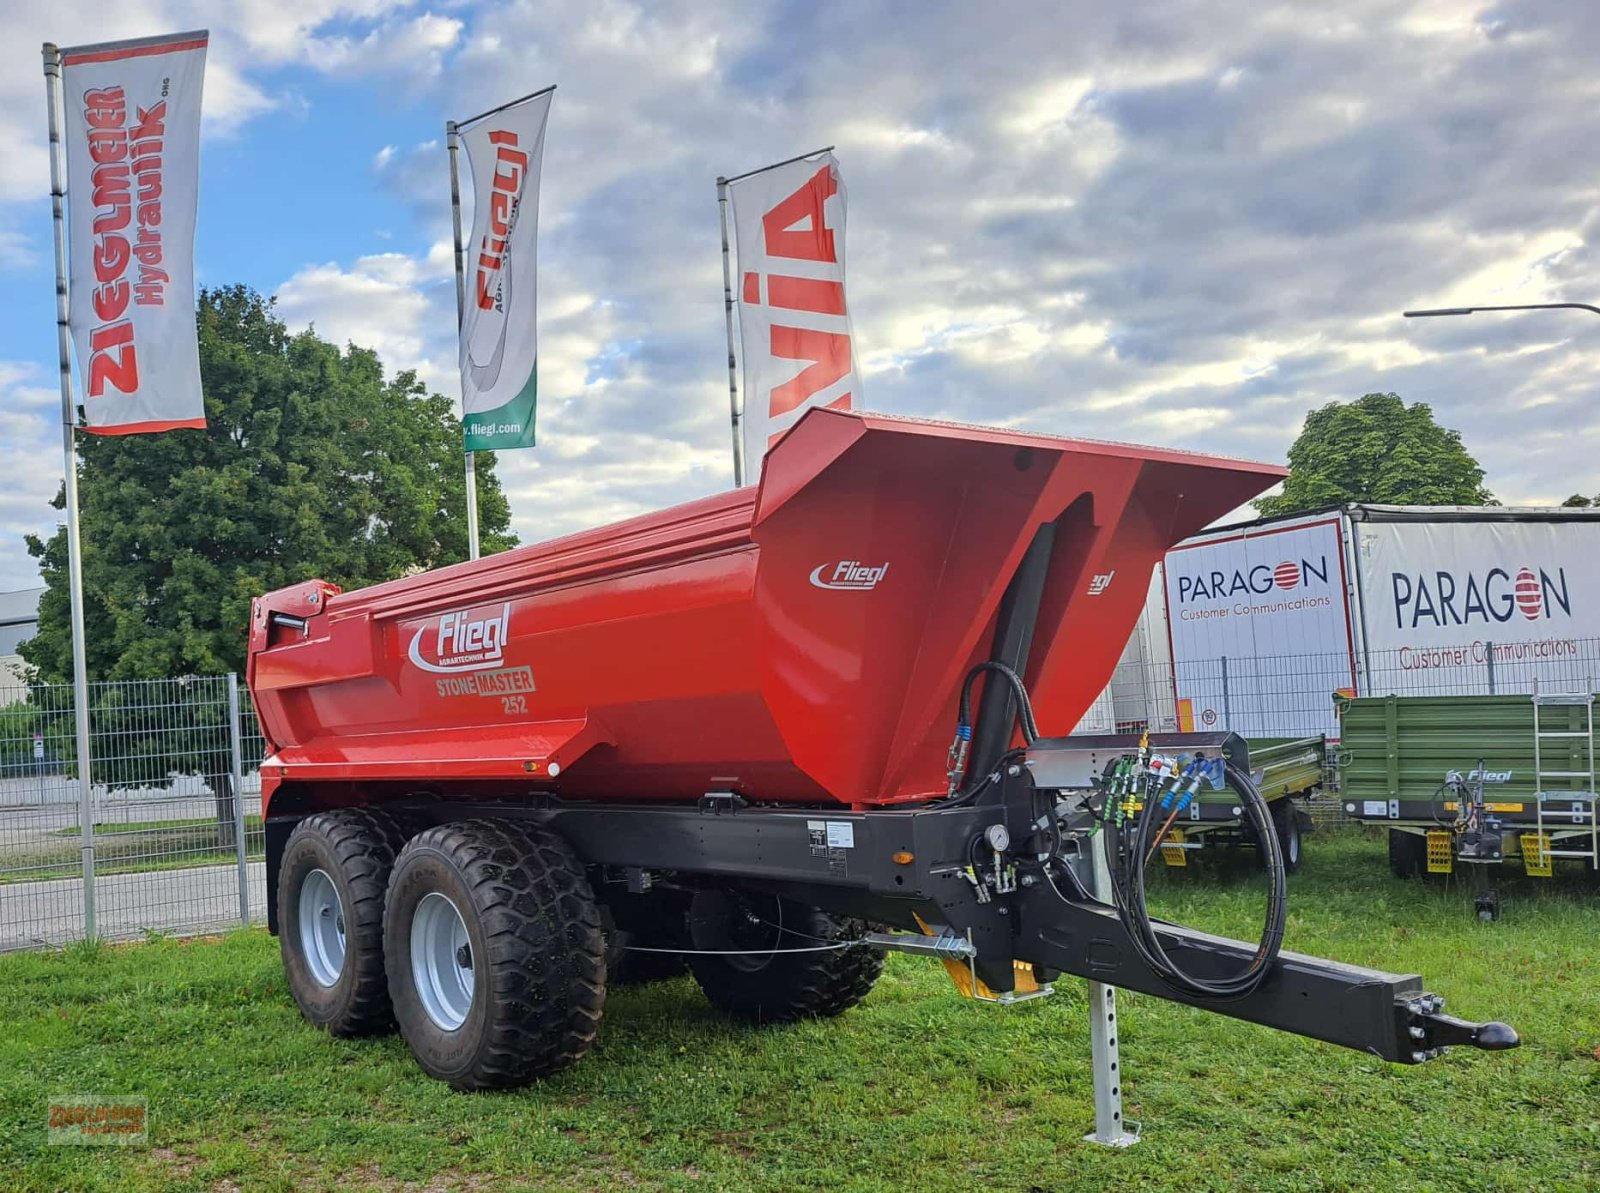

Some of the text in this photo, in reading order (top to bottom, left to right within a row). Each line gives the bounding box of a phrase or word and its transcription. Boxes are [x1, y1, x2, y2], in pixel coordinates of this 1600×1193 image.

[161, 77, 170, 97] OHG
[129, 100, 170, 305] Hydraulik
[477, 130, 527, 310] Fliegl
[832, 561, 890, 586] Fliegl
[1178, 556, 1328, 603] PARAGON
[1180, 596, 1330, 621] Customer Communications
[1392, 567, 1571, 629] PARAGON
[437, 602, 511, 660] Fliegl
[1400, 645, 1468, 671] Customer
[501, 696, 528, 715] 252
